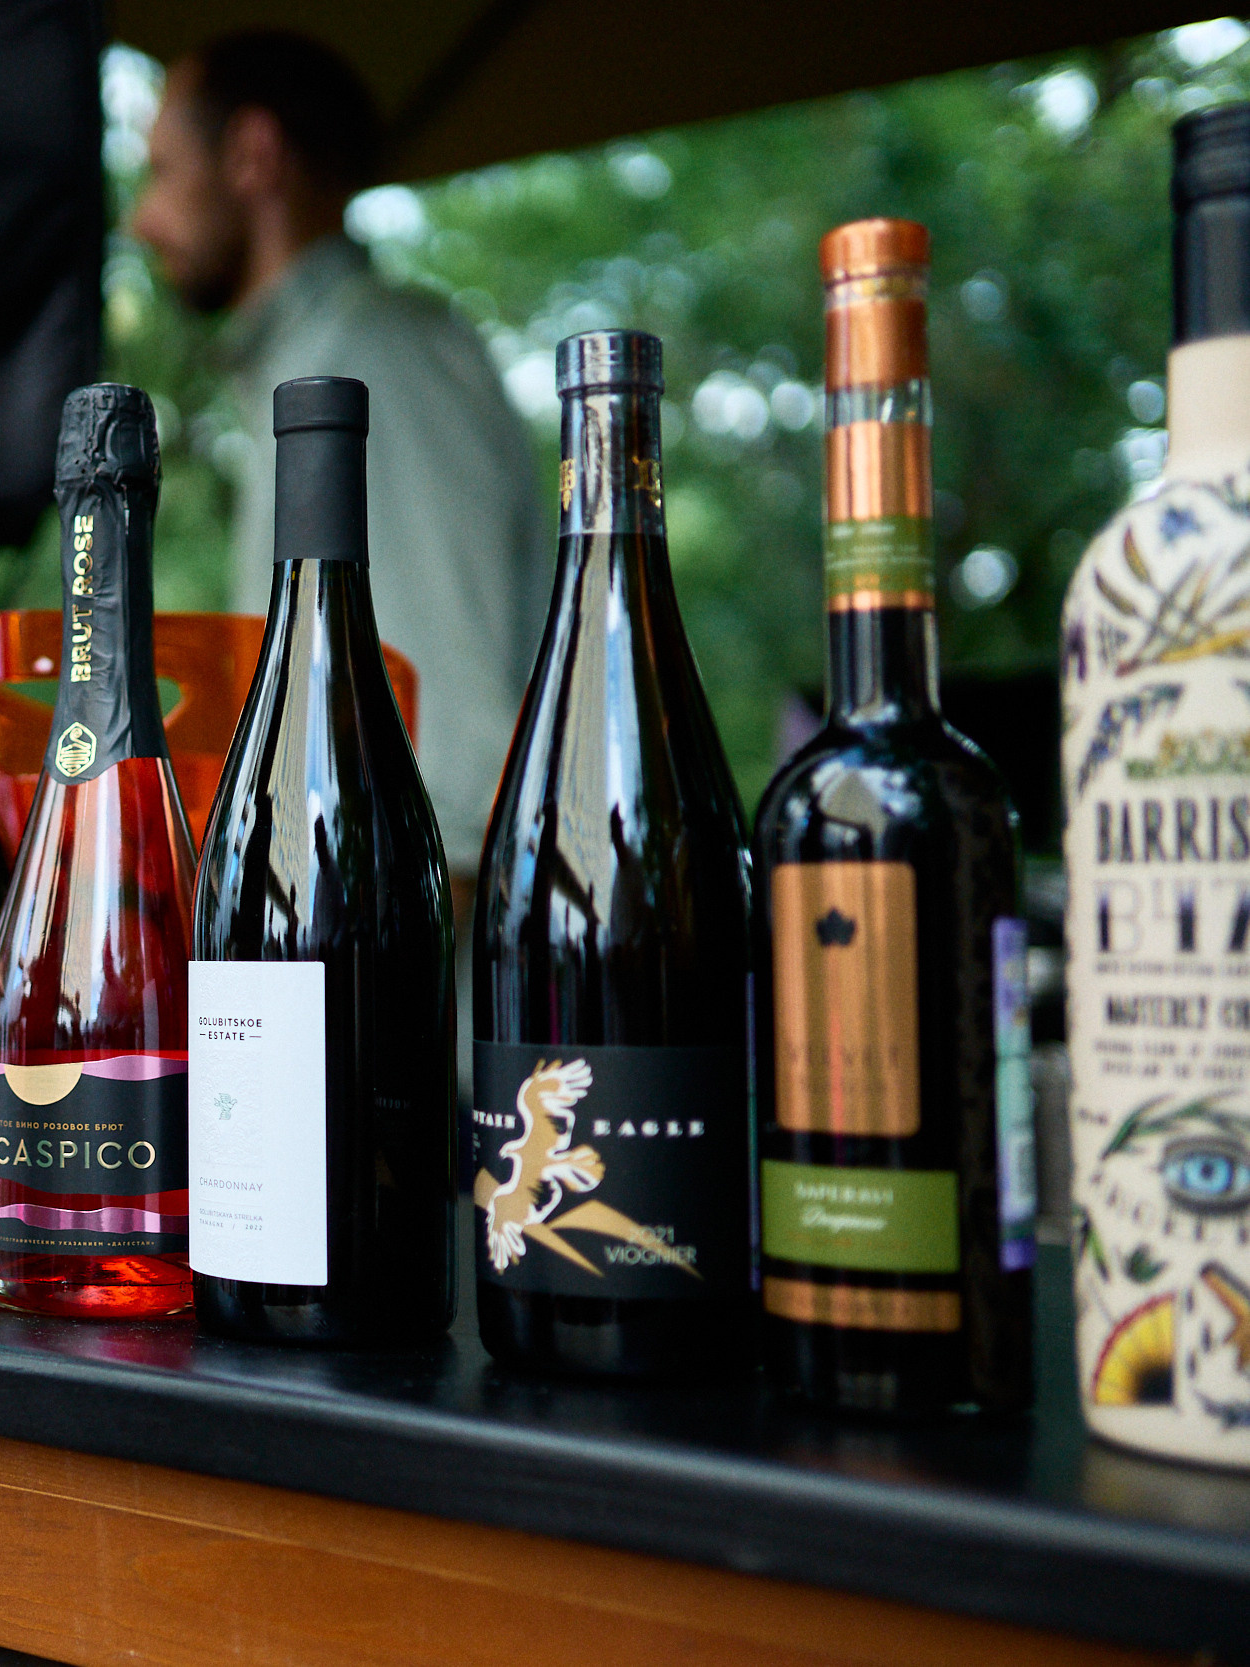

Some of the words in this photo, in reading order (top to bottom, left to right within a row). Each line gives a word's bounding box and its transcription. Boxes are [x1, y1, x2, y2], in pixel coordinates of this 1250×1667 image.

[71, 515, 94, 596] ROSE
[70, 604, 93, 683] BRUT
[198, 1016, 263, 1028] GOLUBITSKOE
[208, 1030, 246, 1041] ESTATE
[16, 1121, 40, 1130] ВИНО
[43, 1122, 90, 1131] РОЗОВОЕ
[95, 1123, 124, 1131] БРЮТ
[593, 1119, 705, 1137] EAGLE
[199, 1176, 263, 1192] CHARDONNAY
[234, 1213, 263, 1222] STRELKA
[604, 1245, 698, 1265] VIOGNIER
